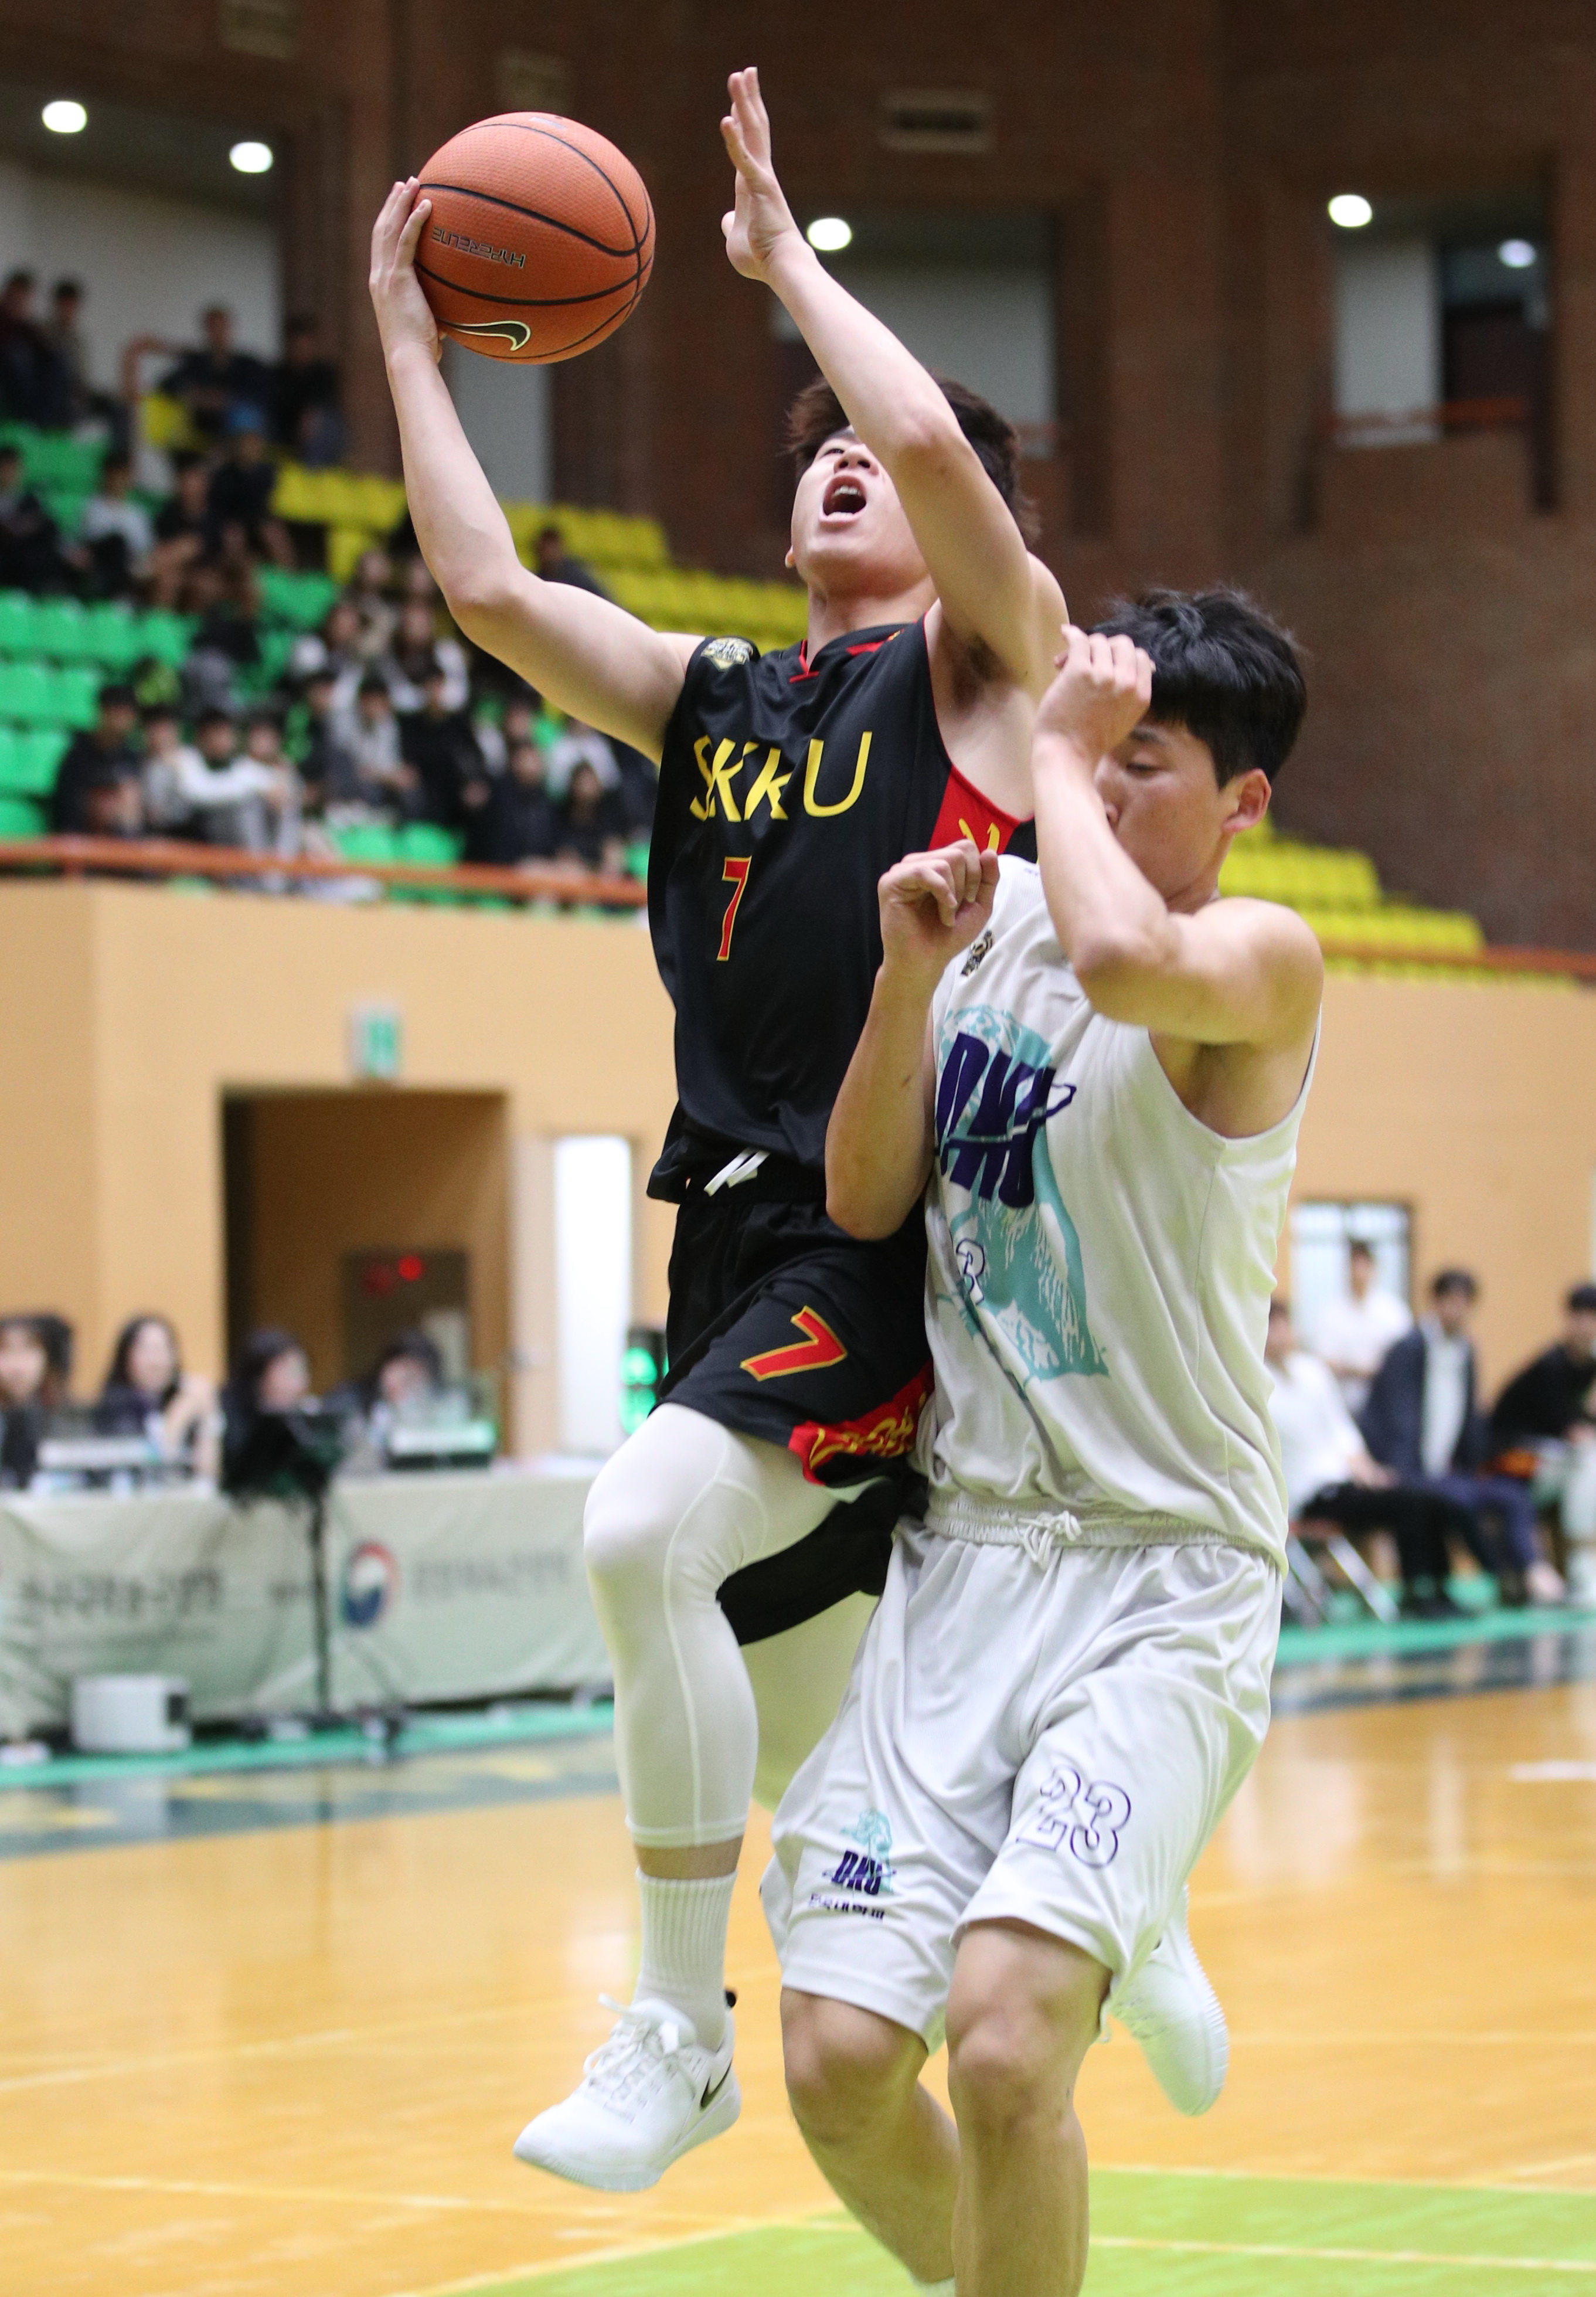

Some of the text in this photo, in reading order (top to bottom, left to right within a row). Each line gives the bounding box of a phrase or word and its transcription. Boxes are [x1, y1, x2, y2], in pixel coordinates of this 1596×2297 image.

[431, 225, 526, 269] HYPERELITE
[689, 731, 873, 822] SKKU
[716, 855, 752, 961] 7
[740, 1305, 848, 1382] 7
[1016, 1763, 1131, 1869] 23
[831, 1849, 883, 1895] DKU
